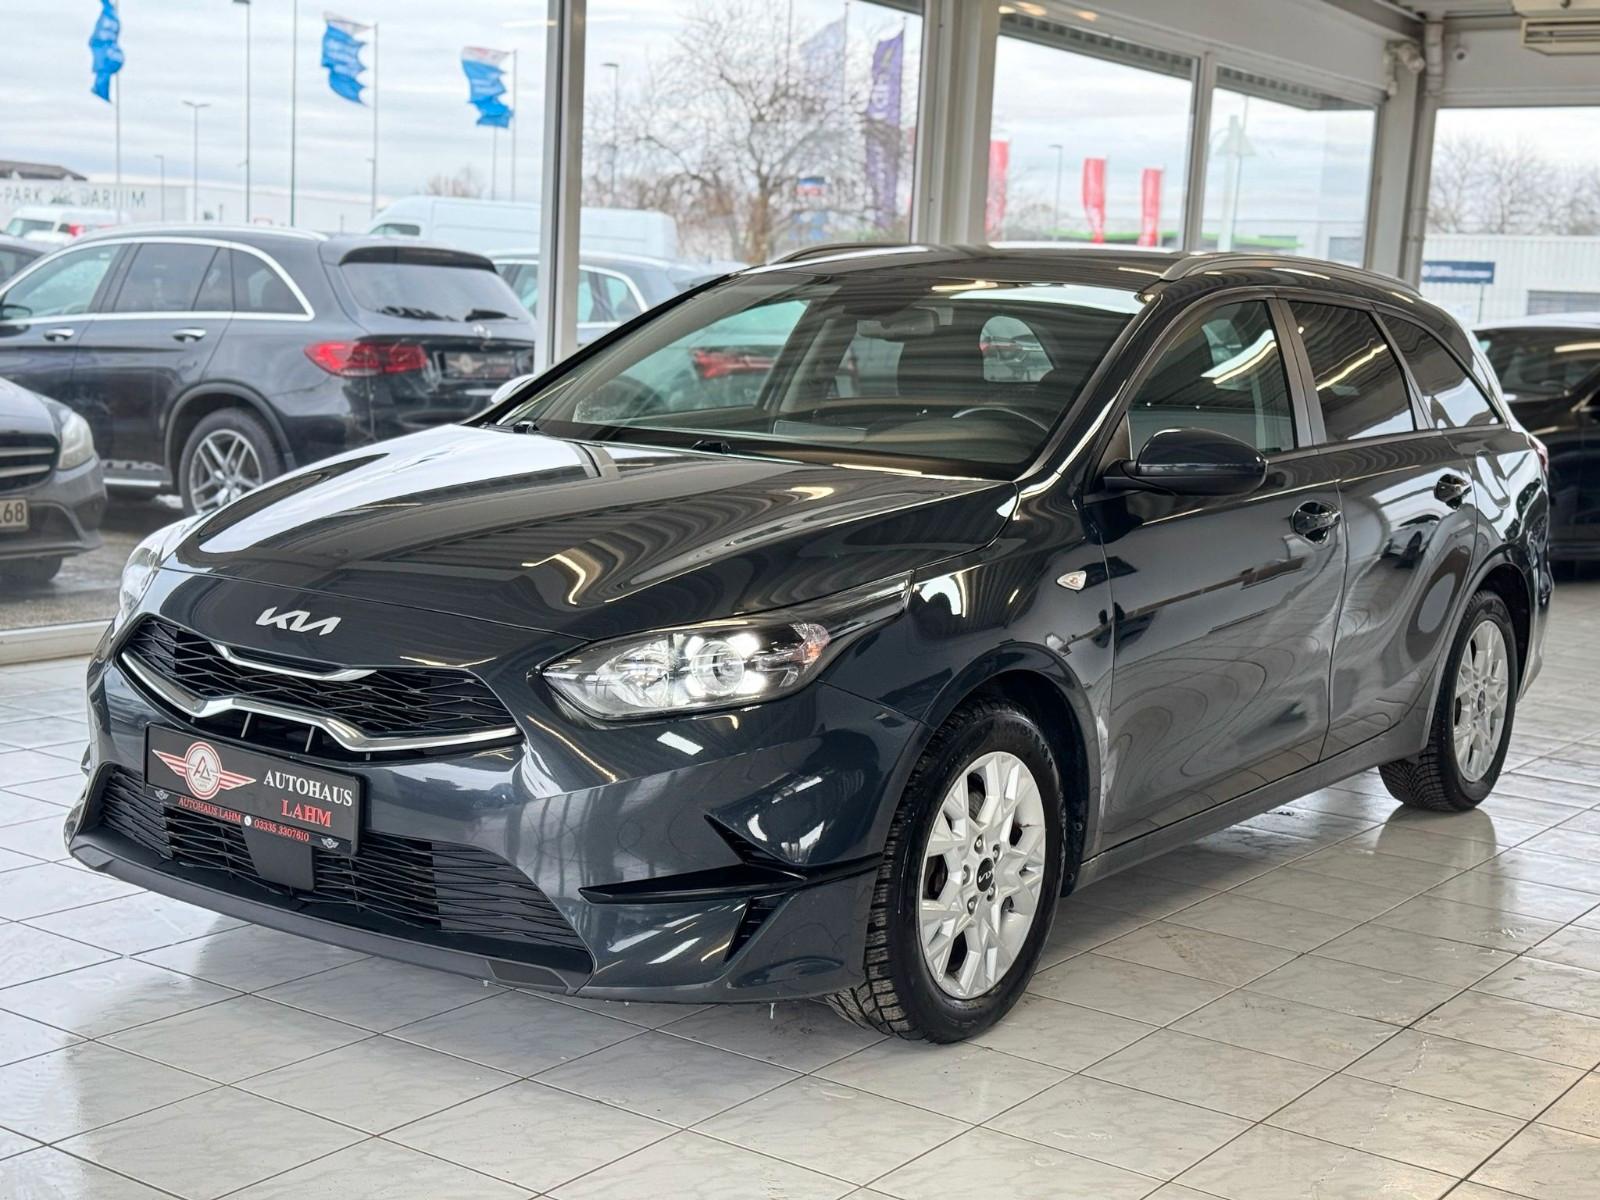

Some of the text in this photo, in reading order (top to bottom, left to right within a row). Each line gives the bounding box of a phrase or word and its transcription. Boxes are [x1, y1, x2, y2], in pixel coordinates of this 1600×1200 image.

[255, 606, 341, 635] KIA
[263, 769, 353, 806] AUTOHAUS
[178, 796, 218, 815] AUTOHAUS
[219, 807, 241, 823] LAHM
[254, 819, 277, 833] 03335
[281, 799, 332, 827] LAHM
